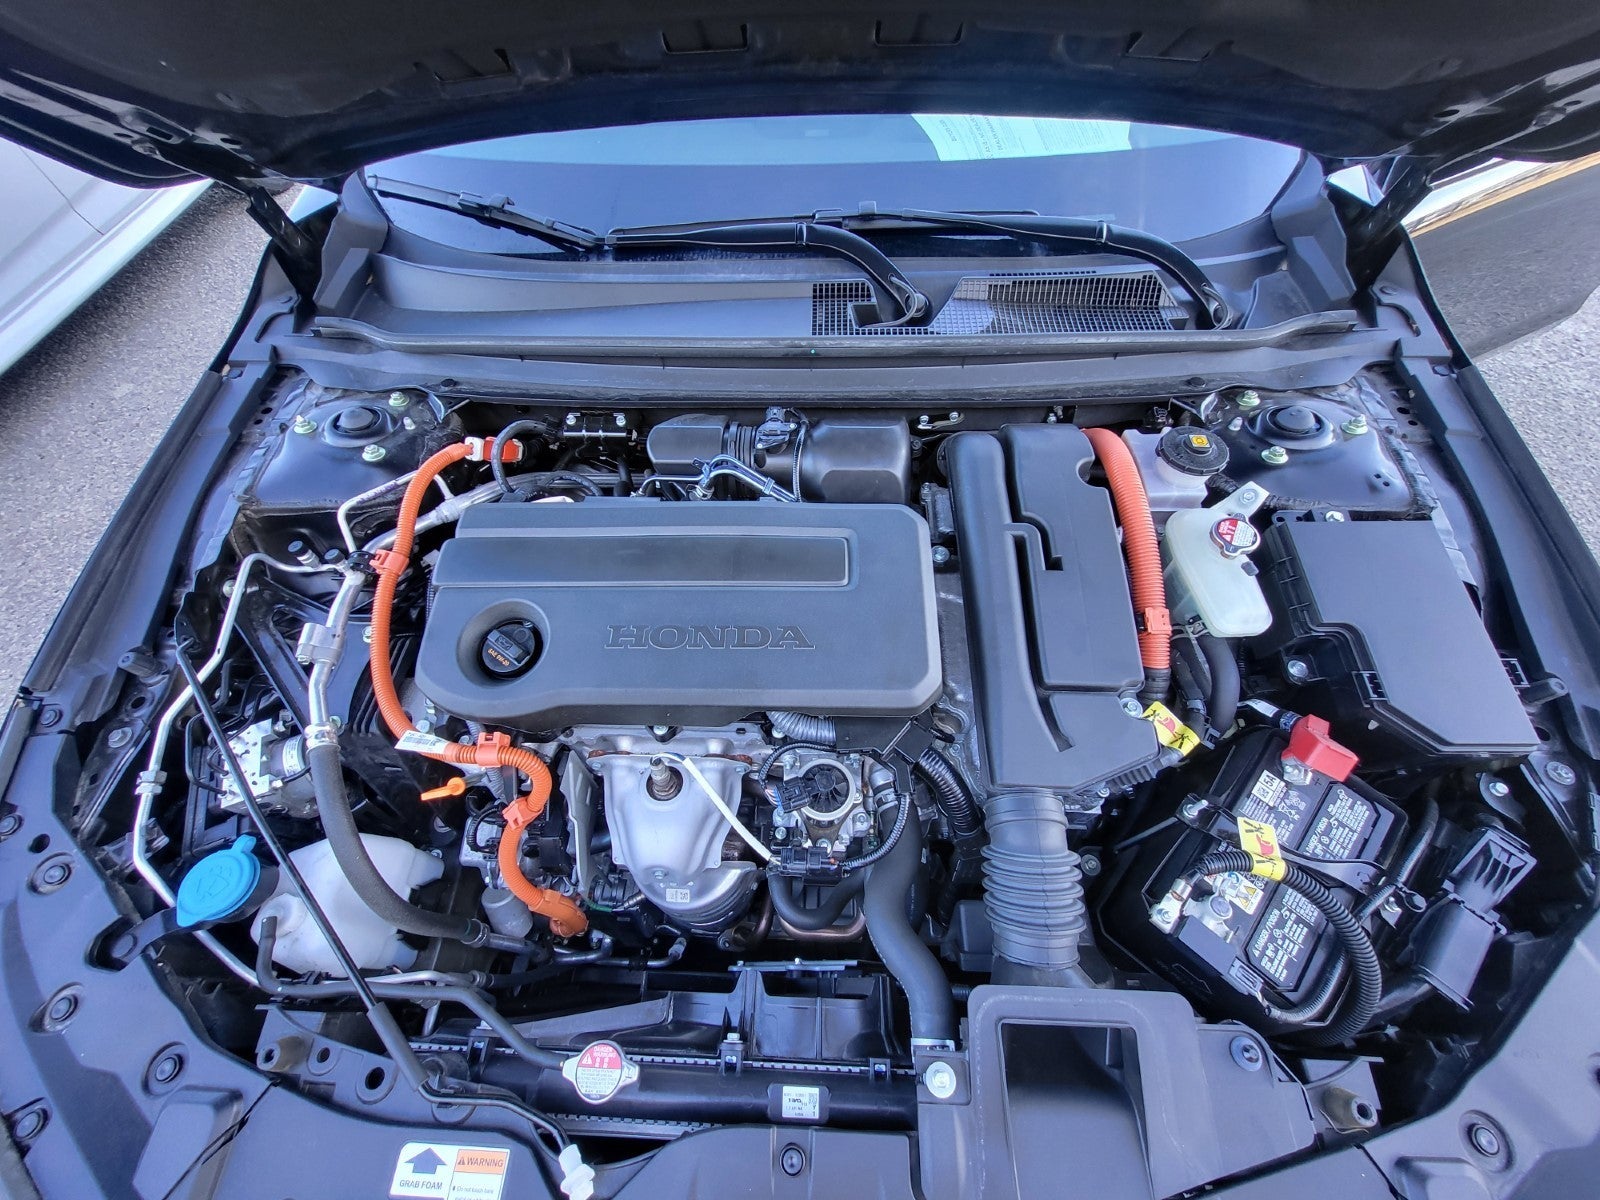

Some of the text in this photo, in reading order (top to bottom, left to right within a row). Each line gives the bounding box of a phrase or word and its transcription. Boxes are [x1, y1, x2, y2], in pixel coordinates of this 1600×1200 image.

[604, 624, 816, 650] HONDA
[467, 1156, 504, 1168] WARNING
[399, 1179, 443, 1190] GRAB FOAM
